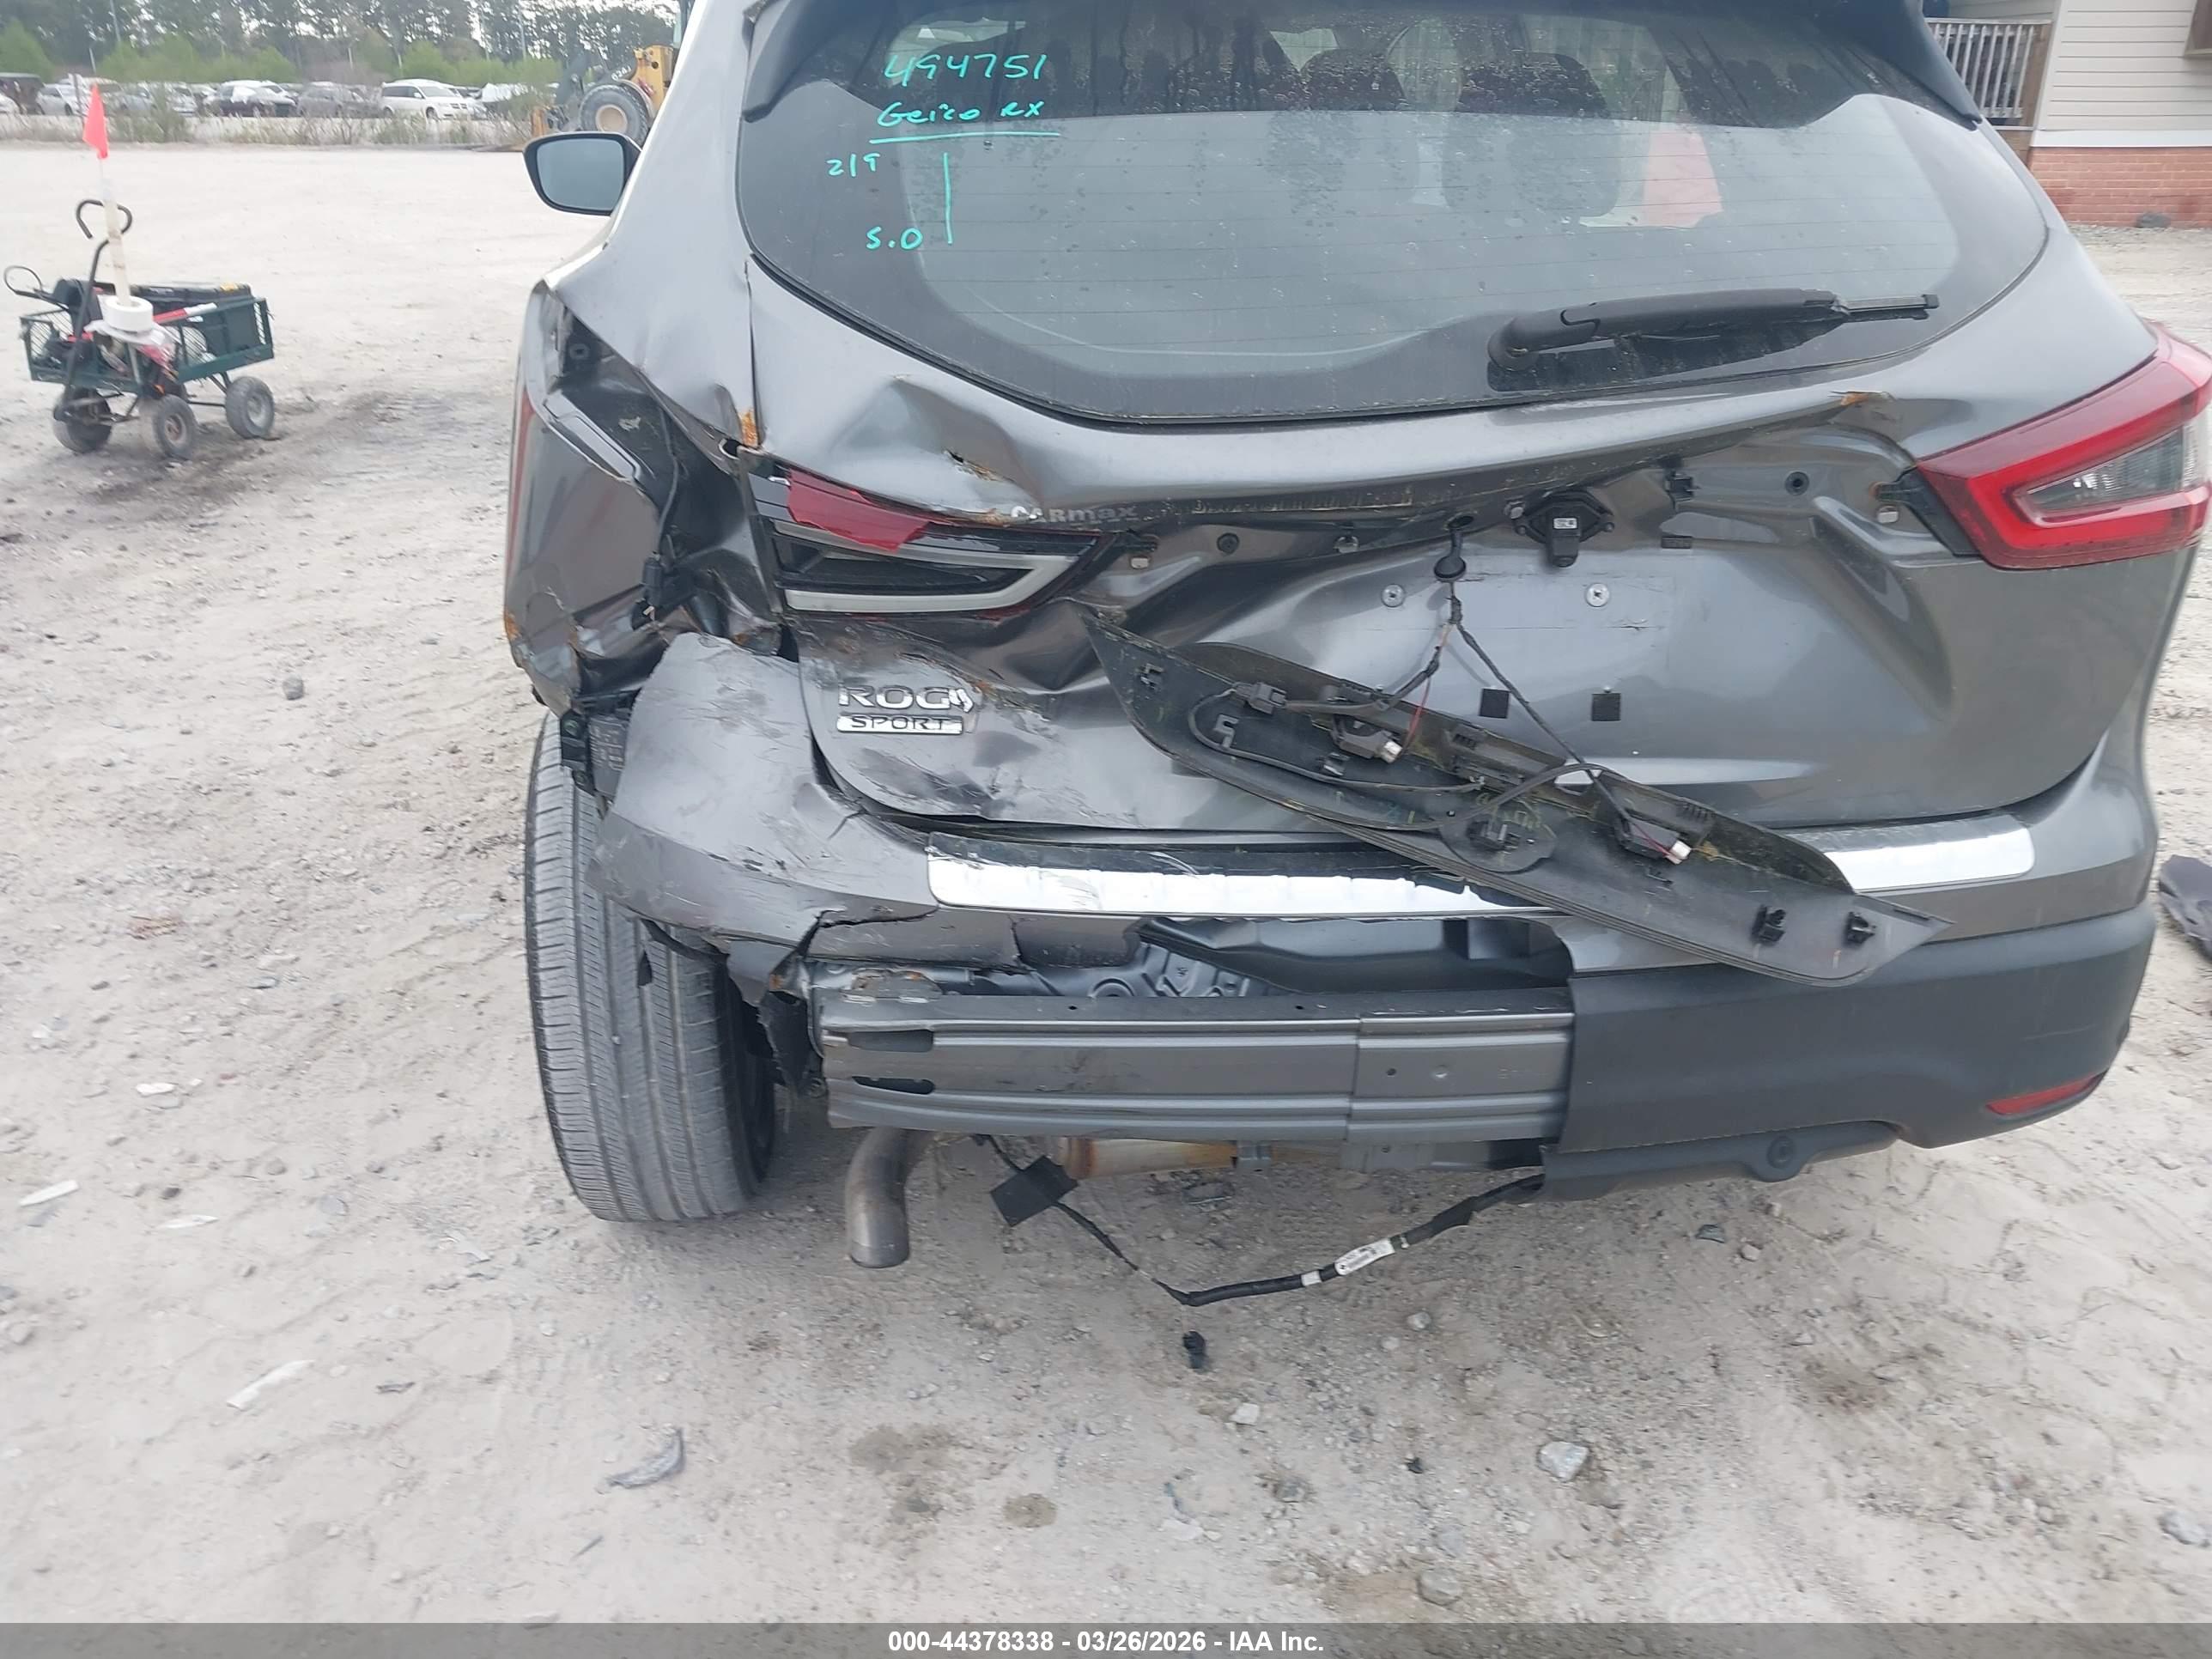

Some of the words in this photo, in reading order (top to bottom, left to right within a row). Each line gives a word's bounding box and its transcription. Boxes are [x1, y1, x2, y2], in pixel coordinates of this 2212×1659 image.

[884, 52, 1048, 87] 494751
[877, 101, 981, 127] Geico
[851, 715, 951, 730] SPORT
